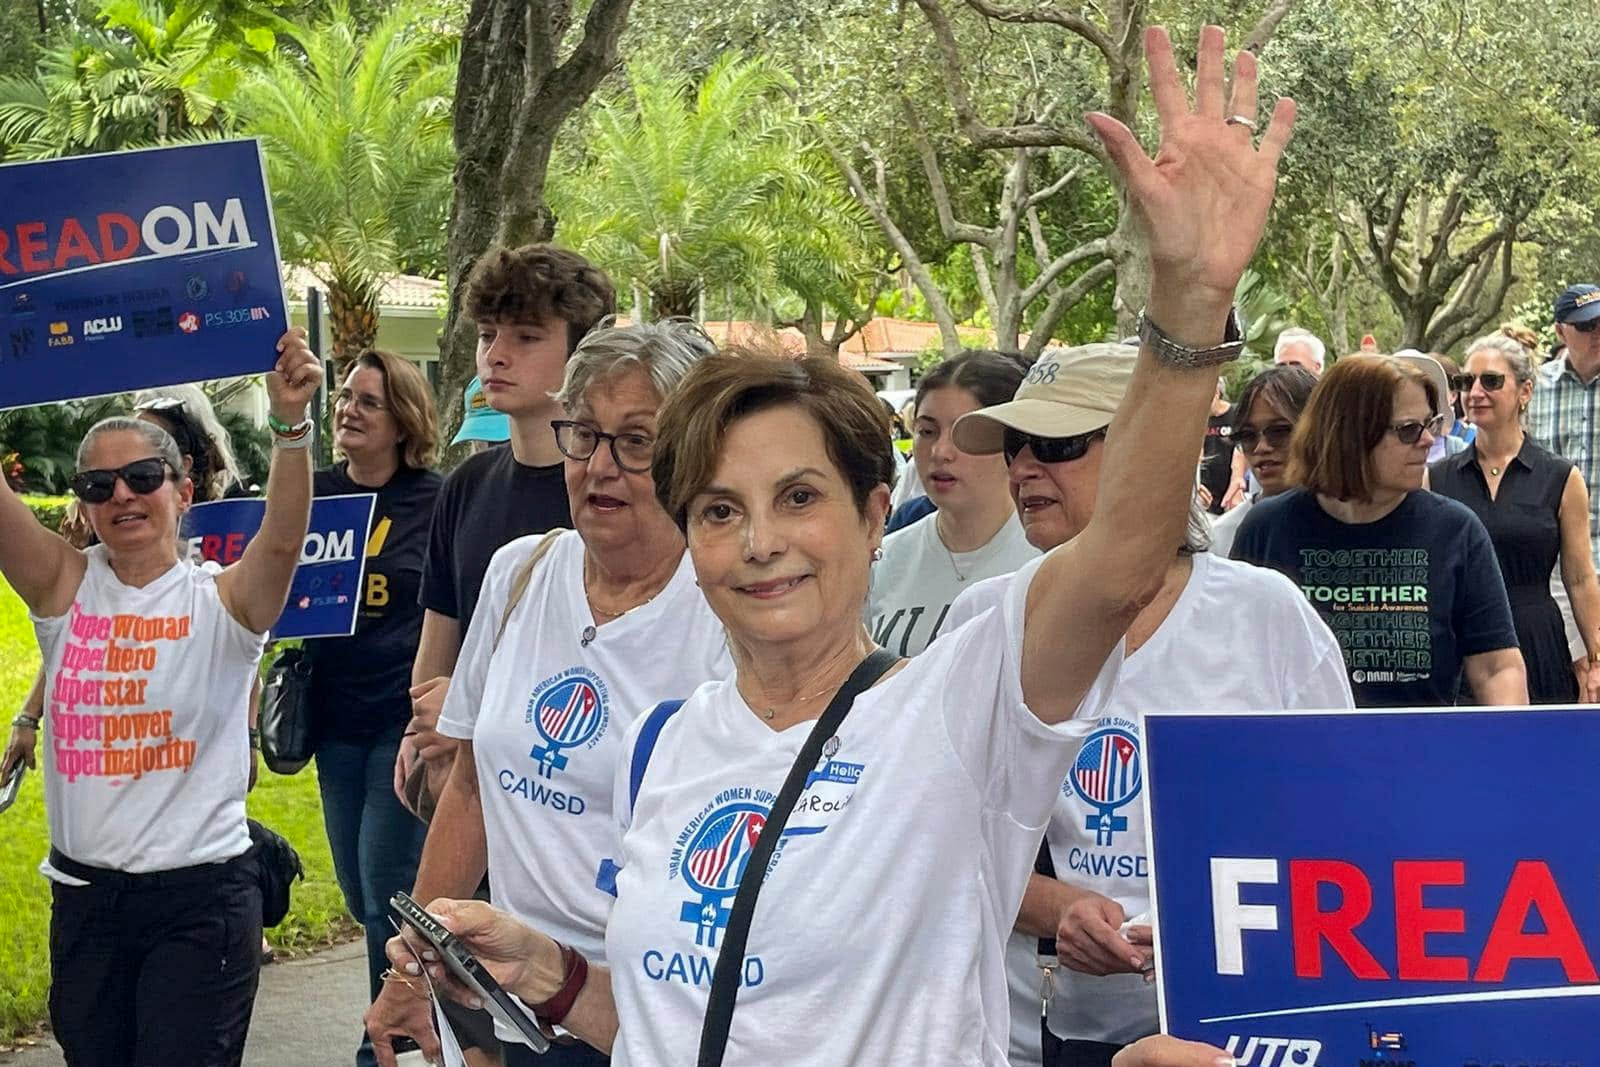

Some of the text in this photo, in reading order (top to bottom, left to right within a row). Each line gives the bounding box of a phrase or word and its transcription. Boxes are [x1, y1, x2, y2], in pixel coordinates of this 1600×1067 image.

[83, 315, 122, 335] ACLU
[1299, 548, 1429, 567] TOGETHER
[1300, 566, 1429, 584] TOGETHER
[1300, 585, 1428, 602] TOGETHER
[1329, 613, 1429, 630] GETHER
[1337, 630, 1431, 649] GETHER
[63, 639, 157, 677] upehero
[1343, 649, 1432, 669] ETHER
[829, 763, 863, 778] Hello
[498, 769, 586, 816] CAWSD
[675, 802, 715, 848] AMERICAN
[714, 787, 752, 806] WOMEN
[642, 949, 765, 988] CAWD
